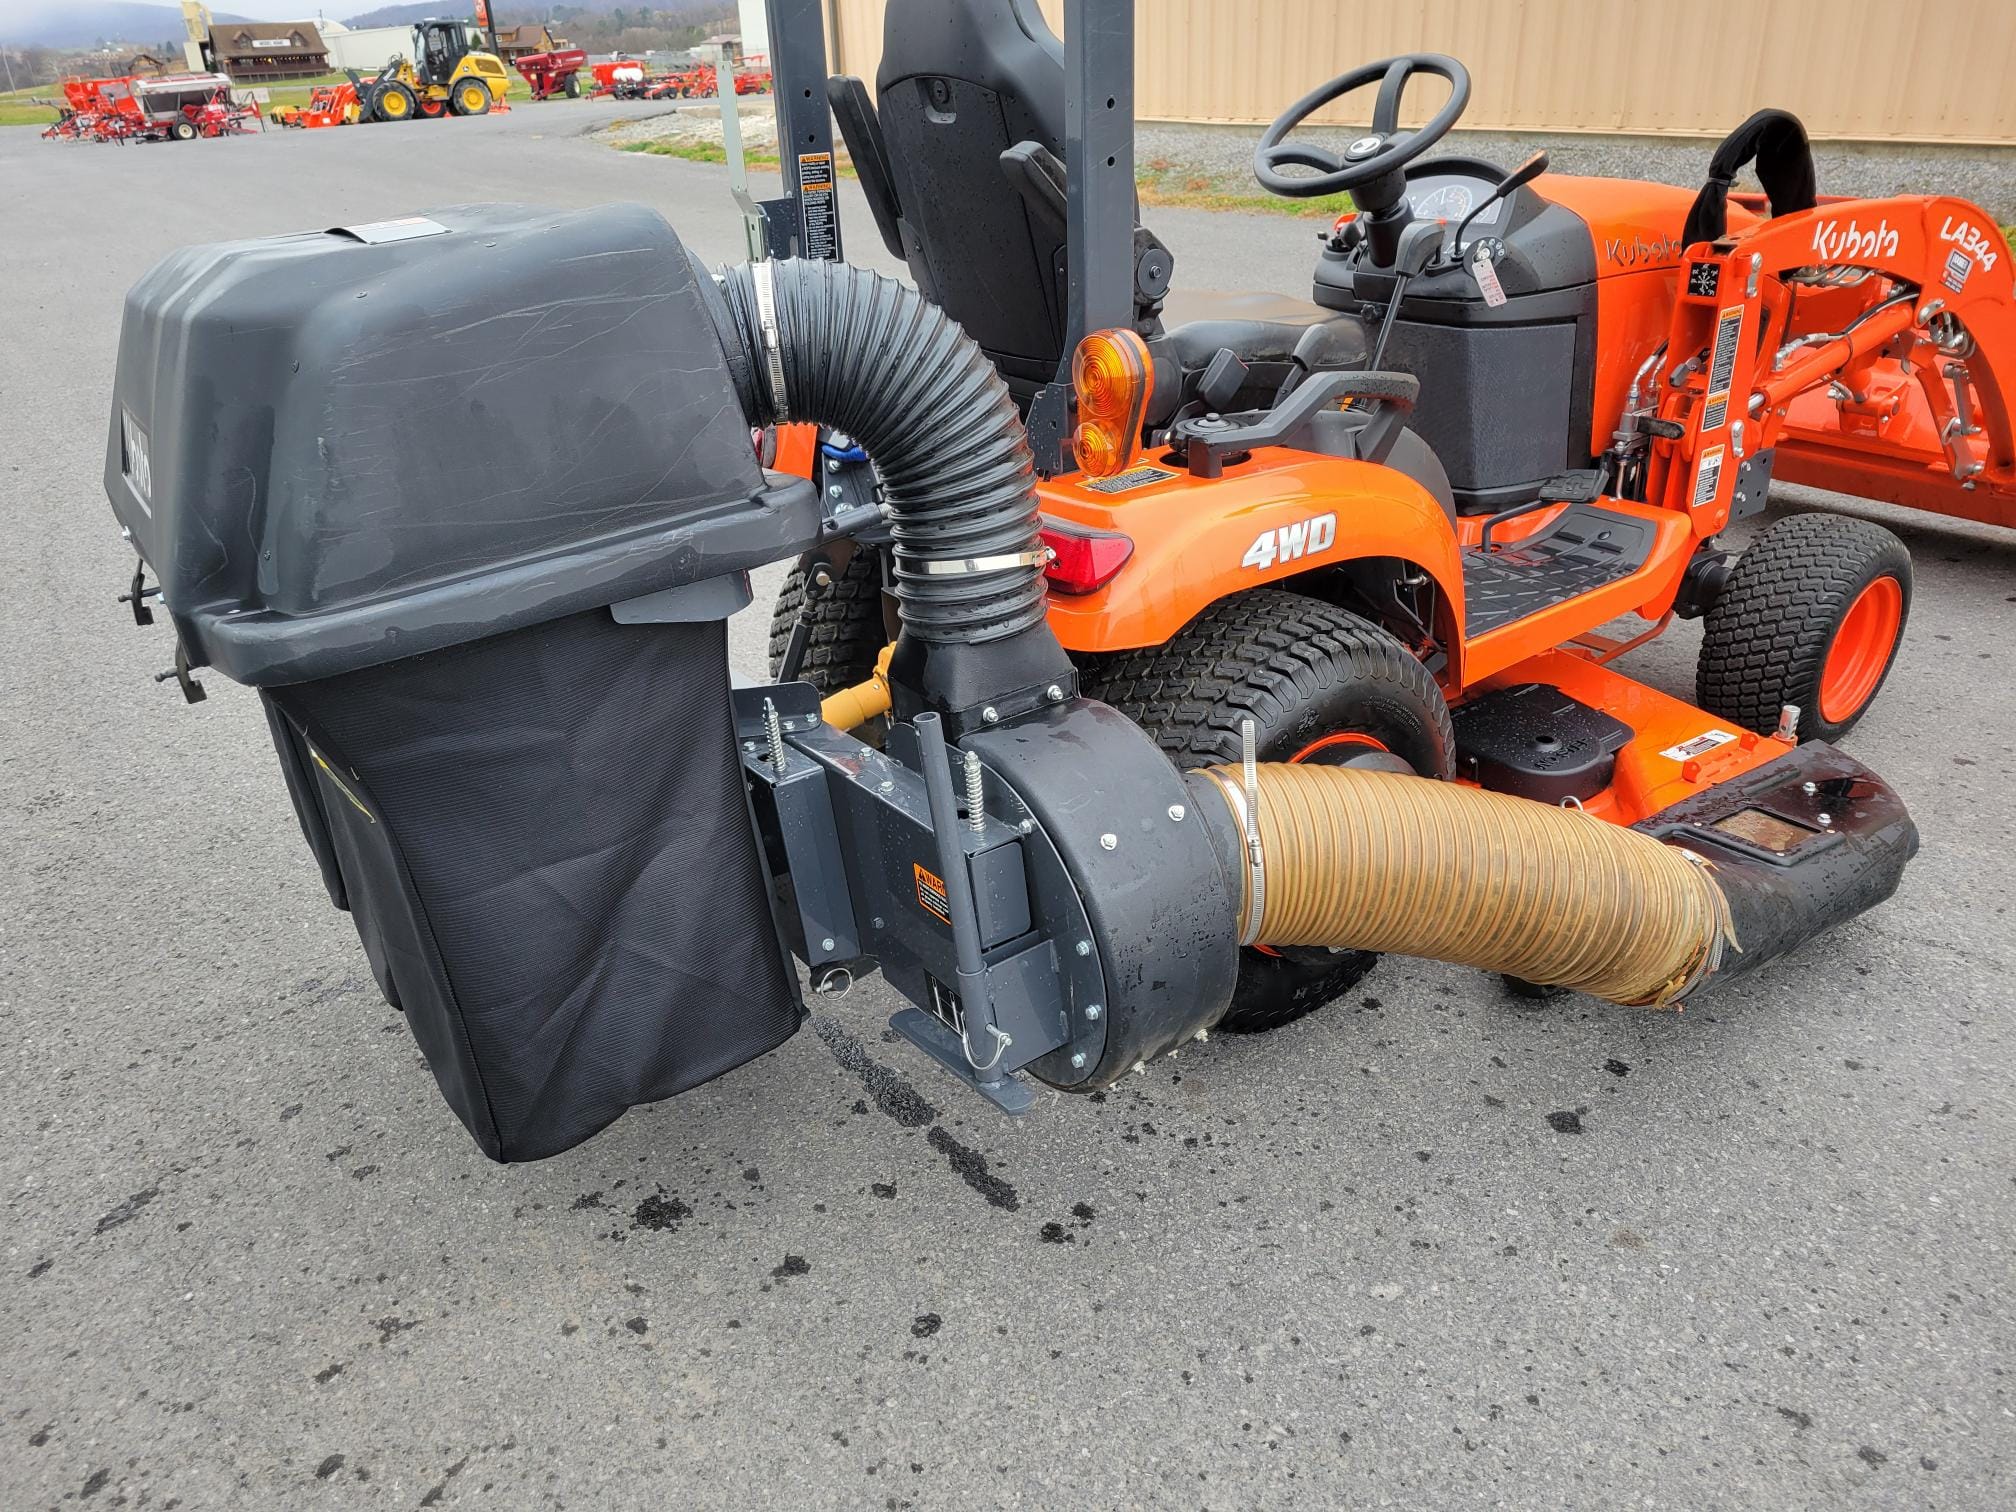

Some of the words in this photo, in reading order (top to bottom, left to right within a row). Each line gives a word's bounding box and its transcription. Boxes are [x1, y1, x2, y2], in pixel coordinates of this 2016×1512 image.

[1605, 233, 1682, 267] Kubota
[1812, 219, 1899, 260] Kubota
[1940, 215, 1998, 273] LA344
[1241, 511, 1338, 571] 4WD
